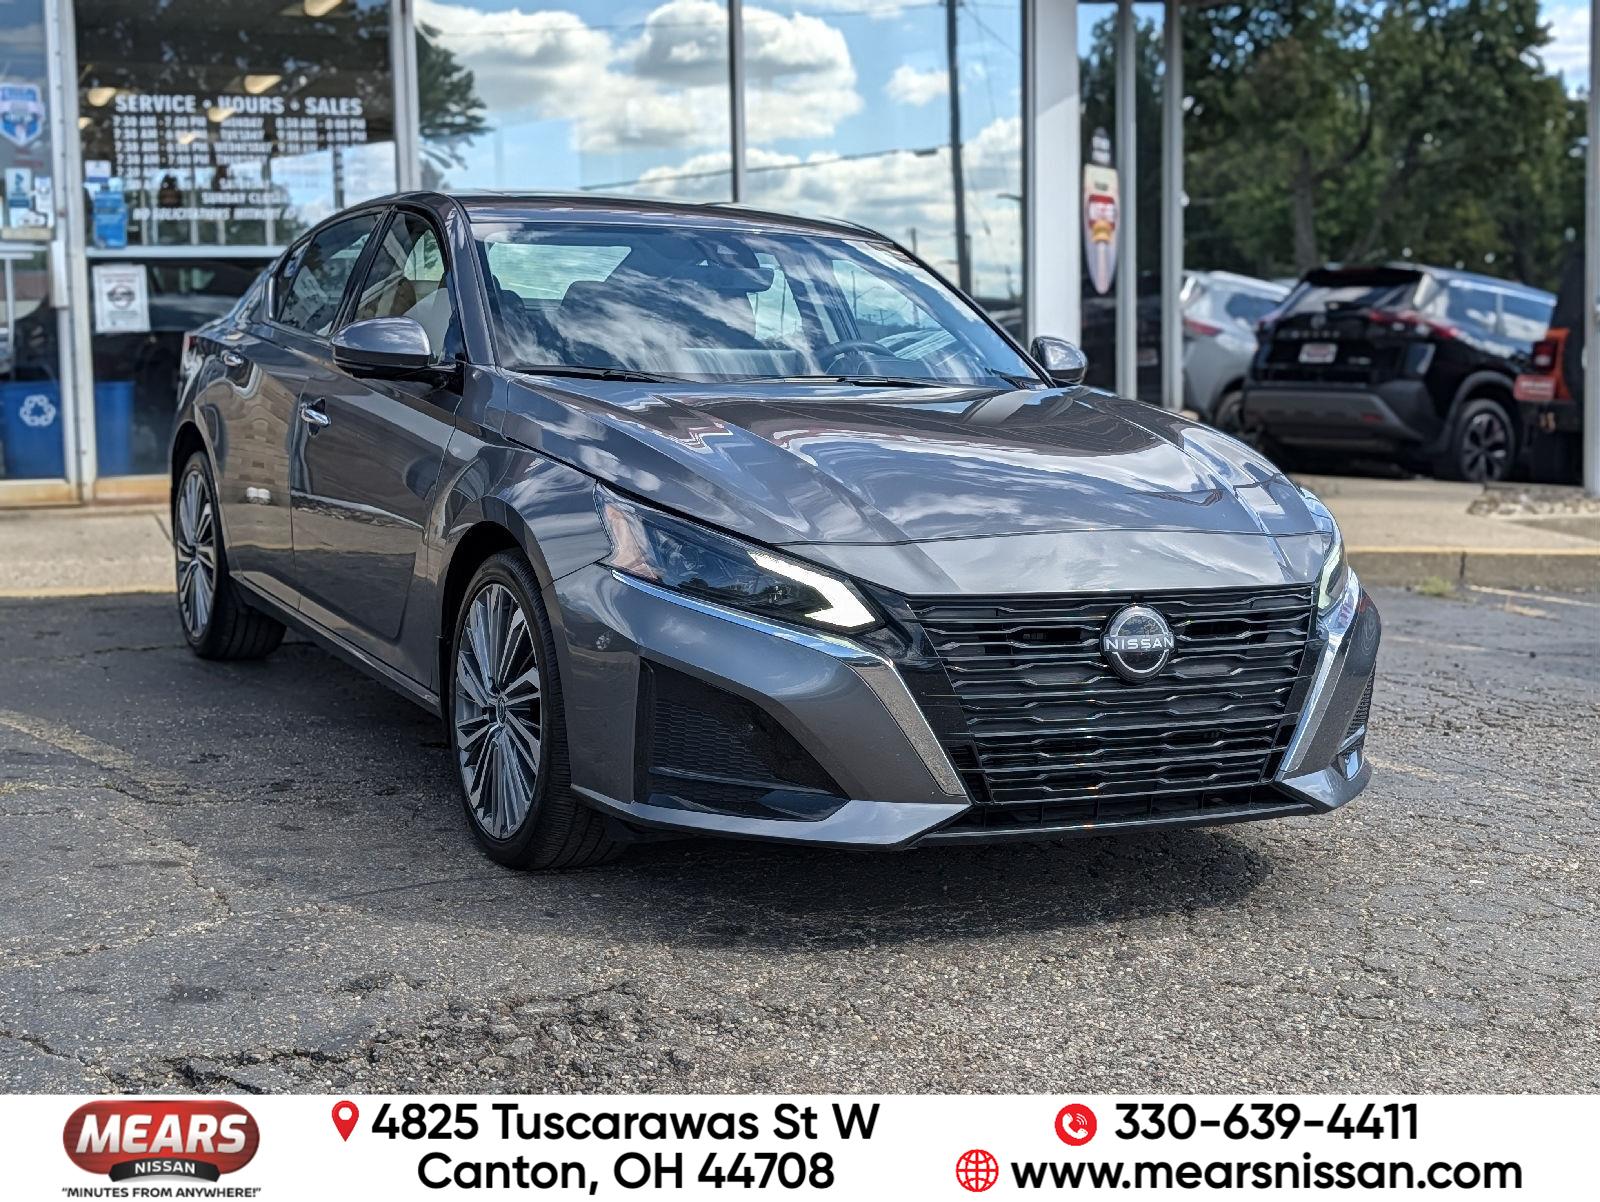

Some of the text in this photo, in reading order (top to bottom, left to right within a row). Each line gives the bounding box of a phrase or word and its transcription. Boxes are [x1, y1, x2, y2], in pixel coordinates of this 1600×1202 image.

[115, 95, 362, 116] SERVICE HOURS SALES
[1104, 636, 1175, 651] NISSAN
